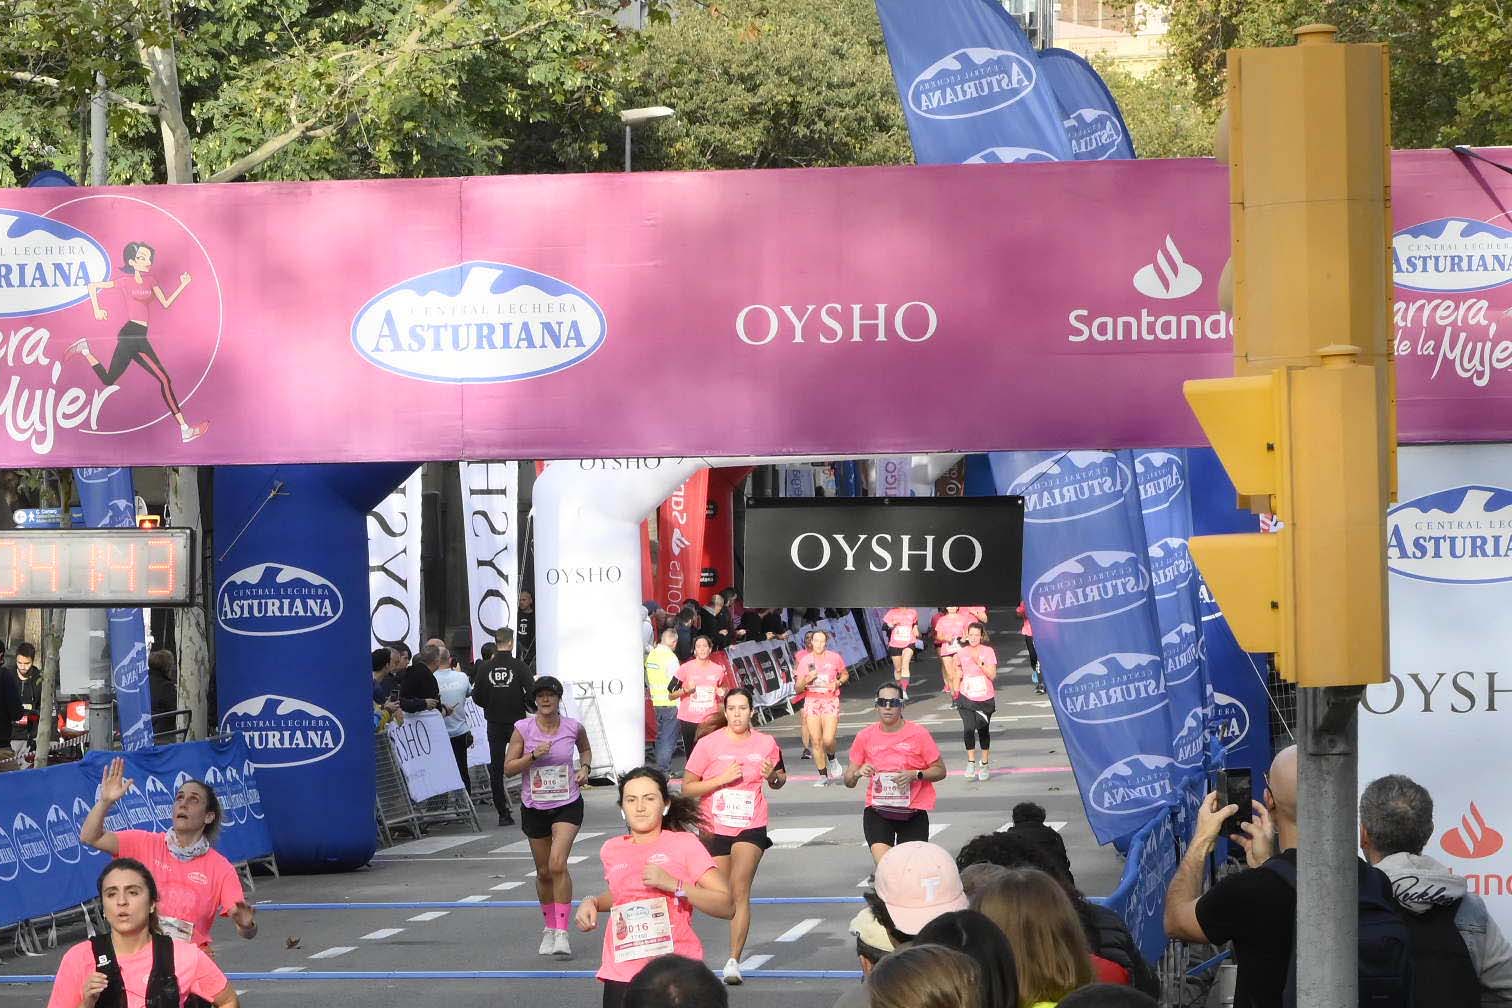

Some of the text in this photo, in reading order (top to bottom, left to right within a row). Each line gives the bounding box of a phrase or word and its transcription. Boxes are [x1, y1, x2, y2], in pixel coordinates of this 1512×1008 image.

[13, 245, 88, 257] LECHERA
[497, 301, 579, 315] LECHERA
[370, 308, 587, 354] ASTURIANA
[734, 301, 938, 346] OYSHO
[1417, 326, 1435, 356] la
[1415, 520, 1482, 530] CENTRAL
[790, 532, 983, 574] OYSHO
[546, 565, 622, 586] OYSHO
[233, 587, 330, 597] CENTRAL LECHERA
[220, 592, 334, 620] ASTURIANA
[494, 671, 507, 681] BP
[235, 719, 331, 728] CENTRAL LECHERA
